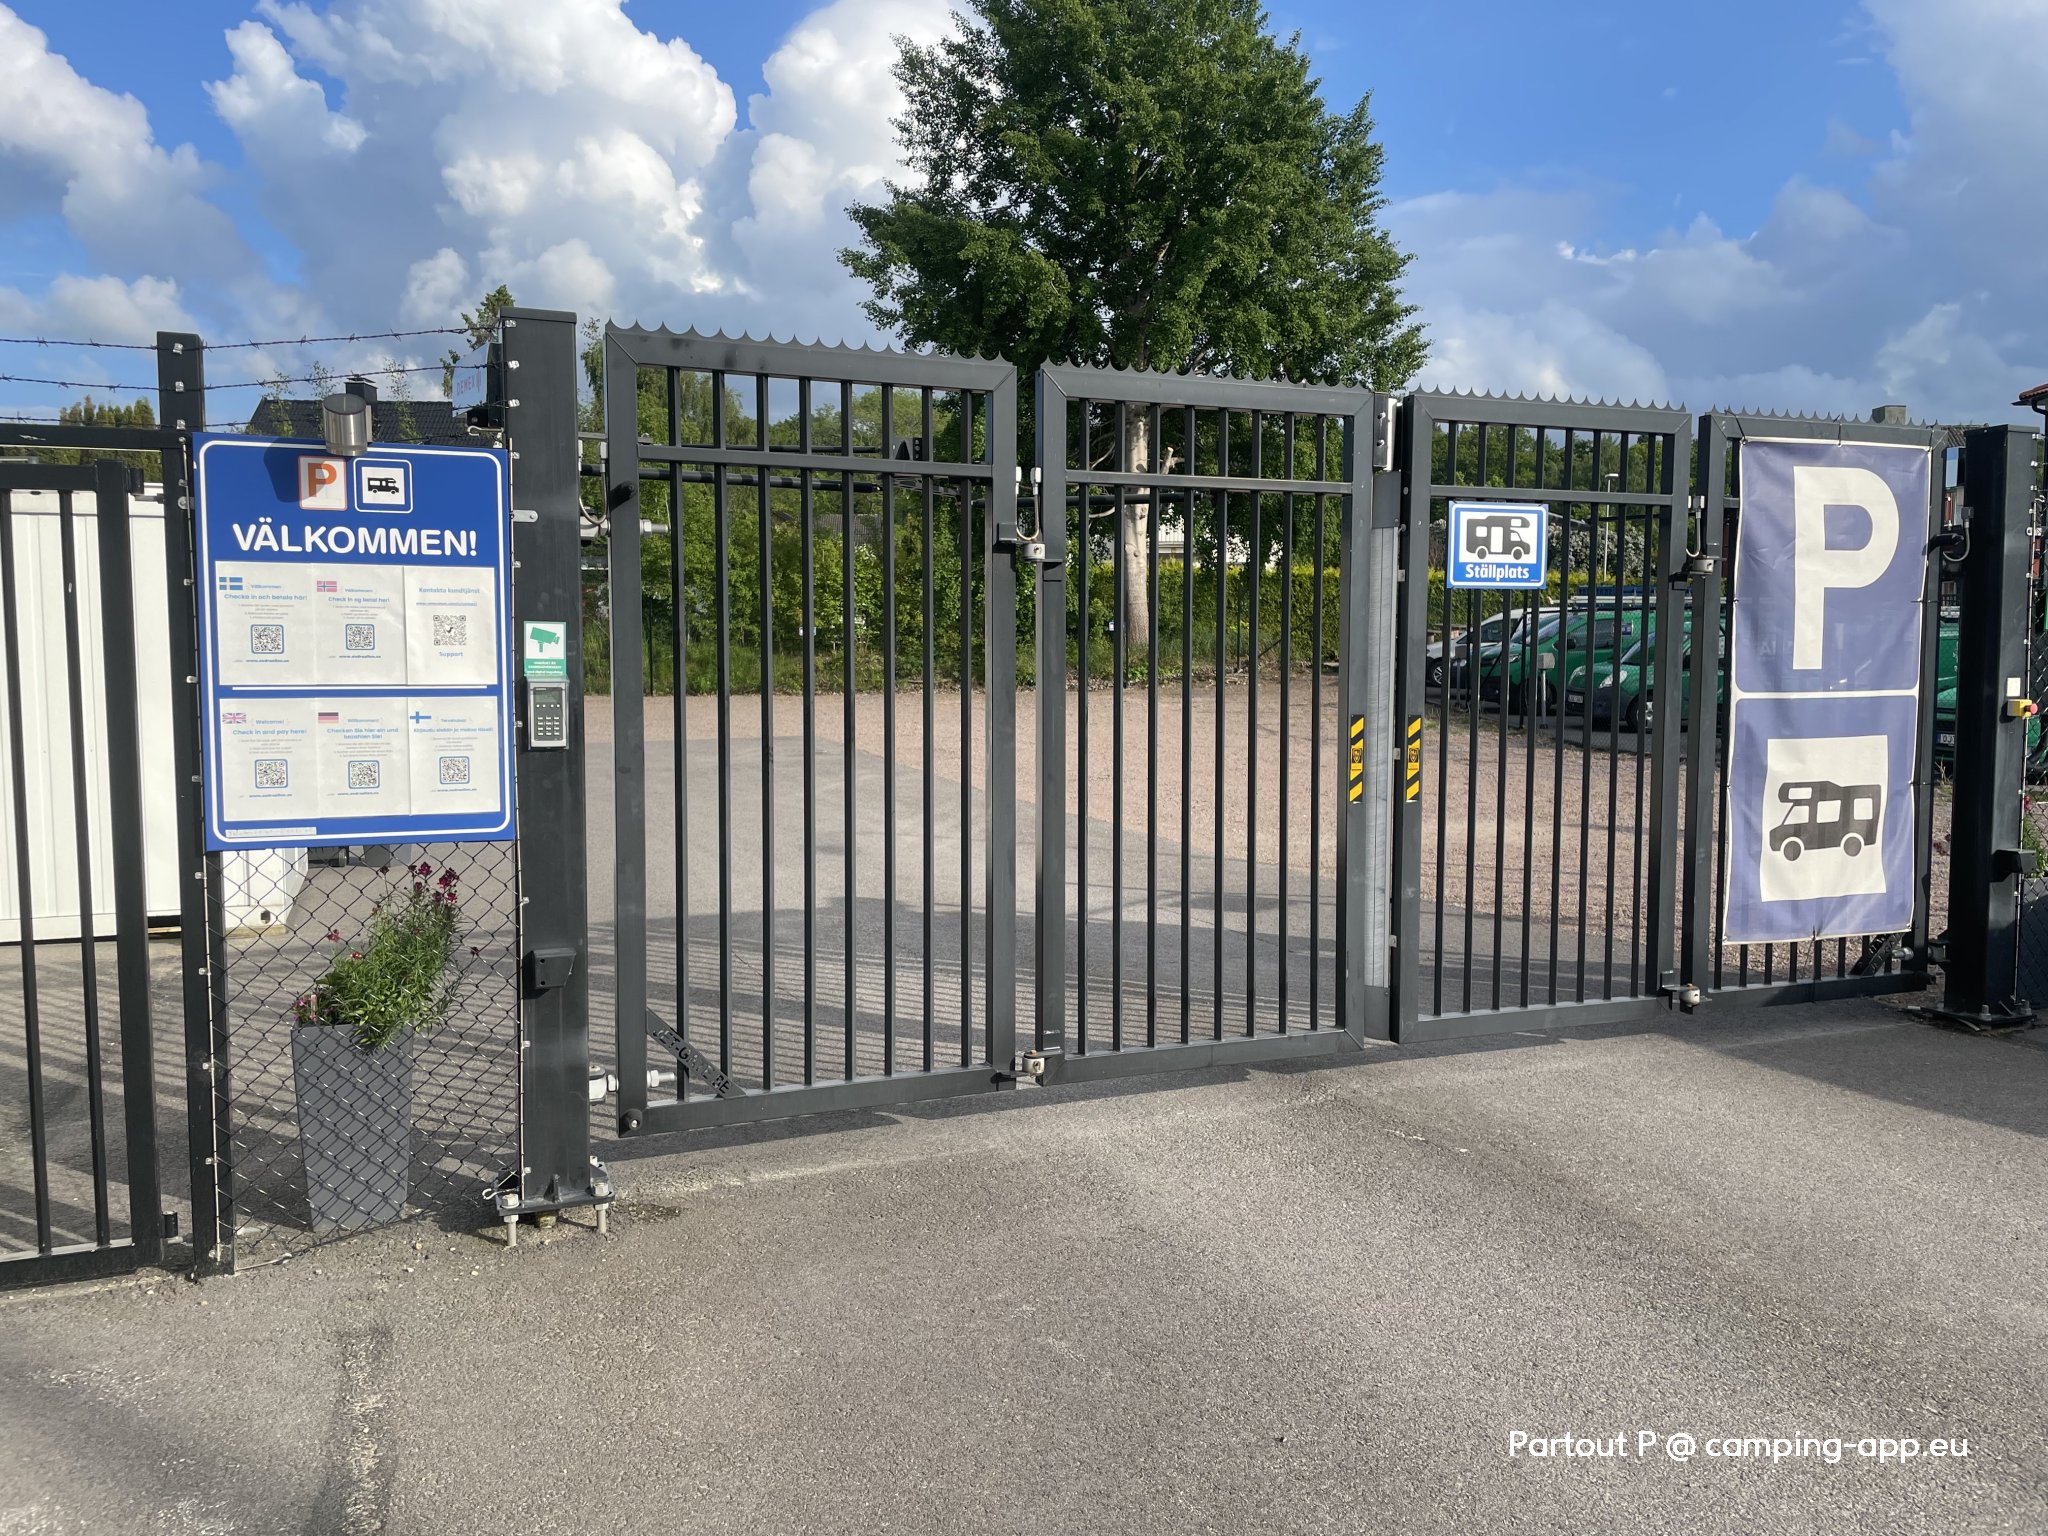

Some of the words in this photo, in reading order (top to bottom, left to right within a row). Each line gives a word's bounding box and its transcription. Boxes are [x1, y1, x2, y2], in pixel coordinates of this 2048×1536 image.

[307, 462, 337, 498] P
[232, 516, 478, 557] VÄLKOMMEN!
[1465, 563, 1530, 582] Ställplats
[1792, 465, 1900, 670] P
